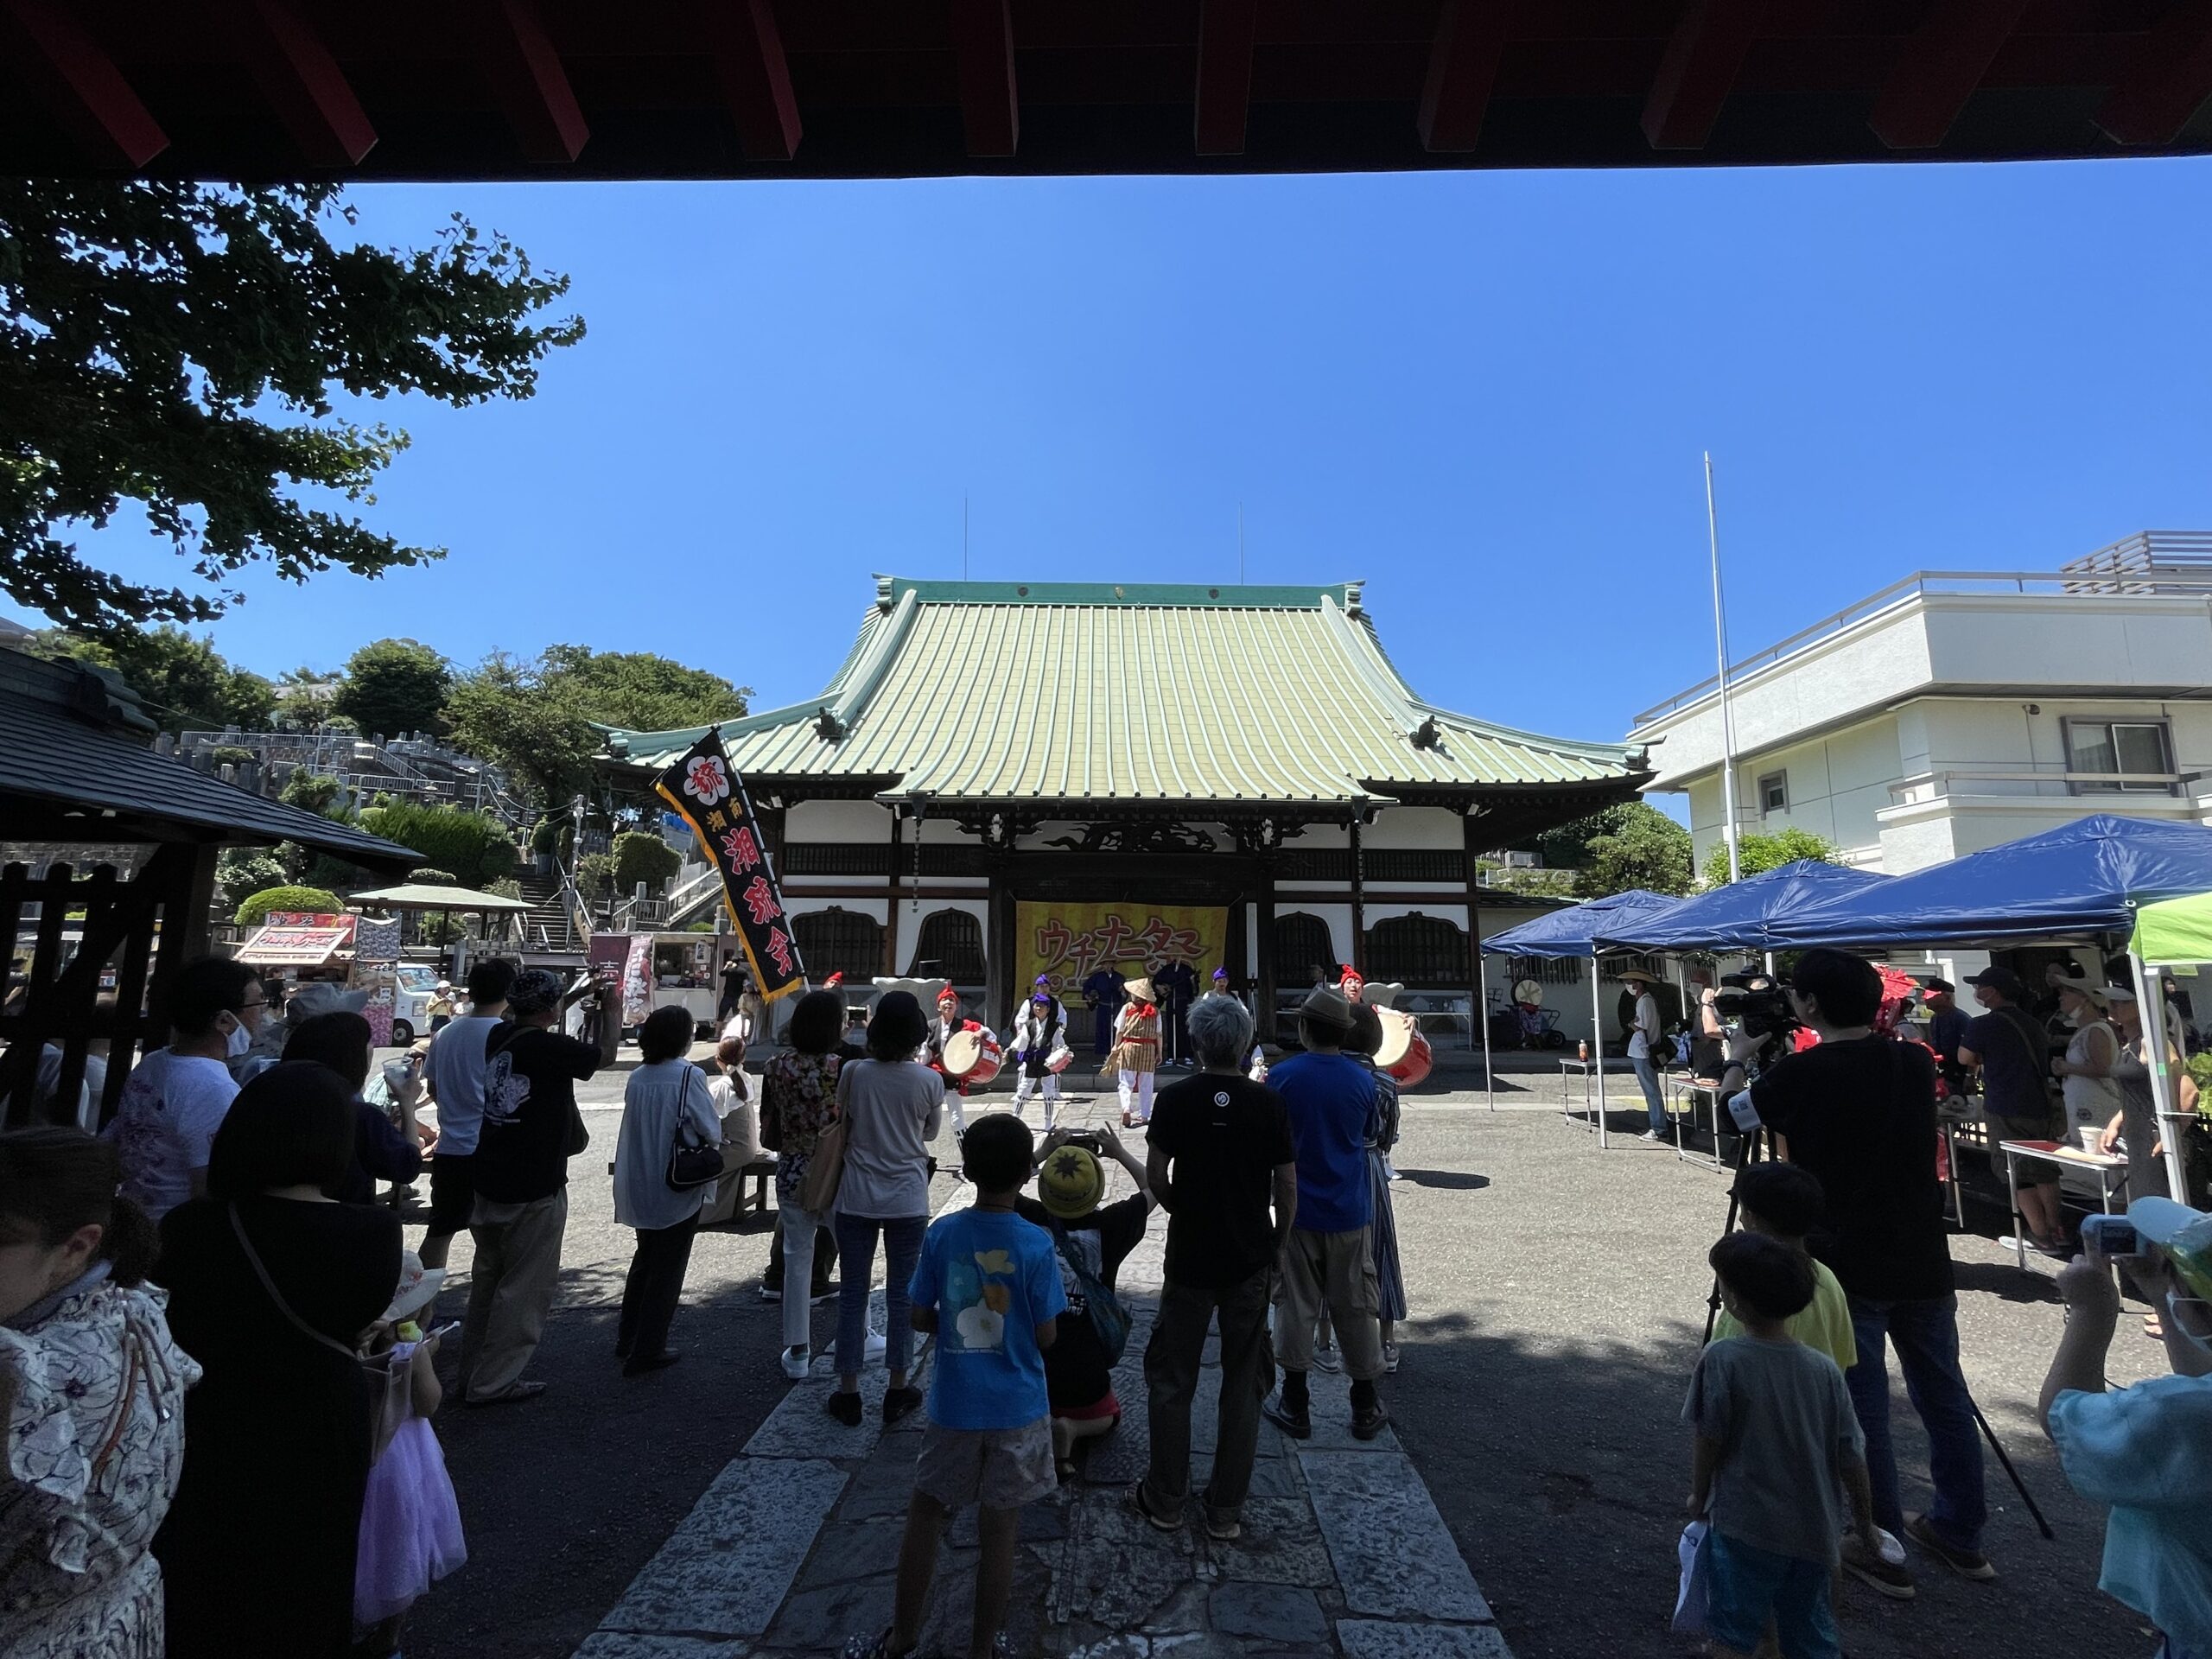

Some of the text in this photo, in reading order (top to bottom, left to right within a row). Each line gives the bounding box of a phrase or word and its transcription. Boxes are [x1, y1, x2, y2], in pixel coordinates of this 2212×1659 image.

[705, 796, 745, 832] 湘南
[721, 825, 793, 977] 湘琉会
[1039, 915, 1203, 978] ウチナー祭
